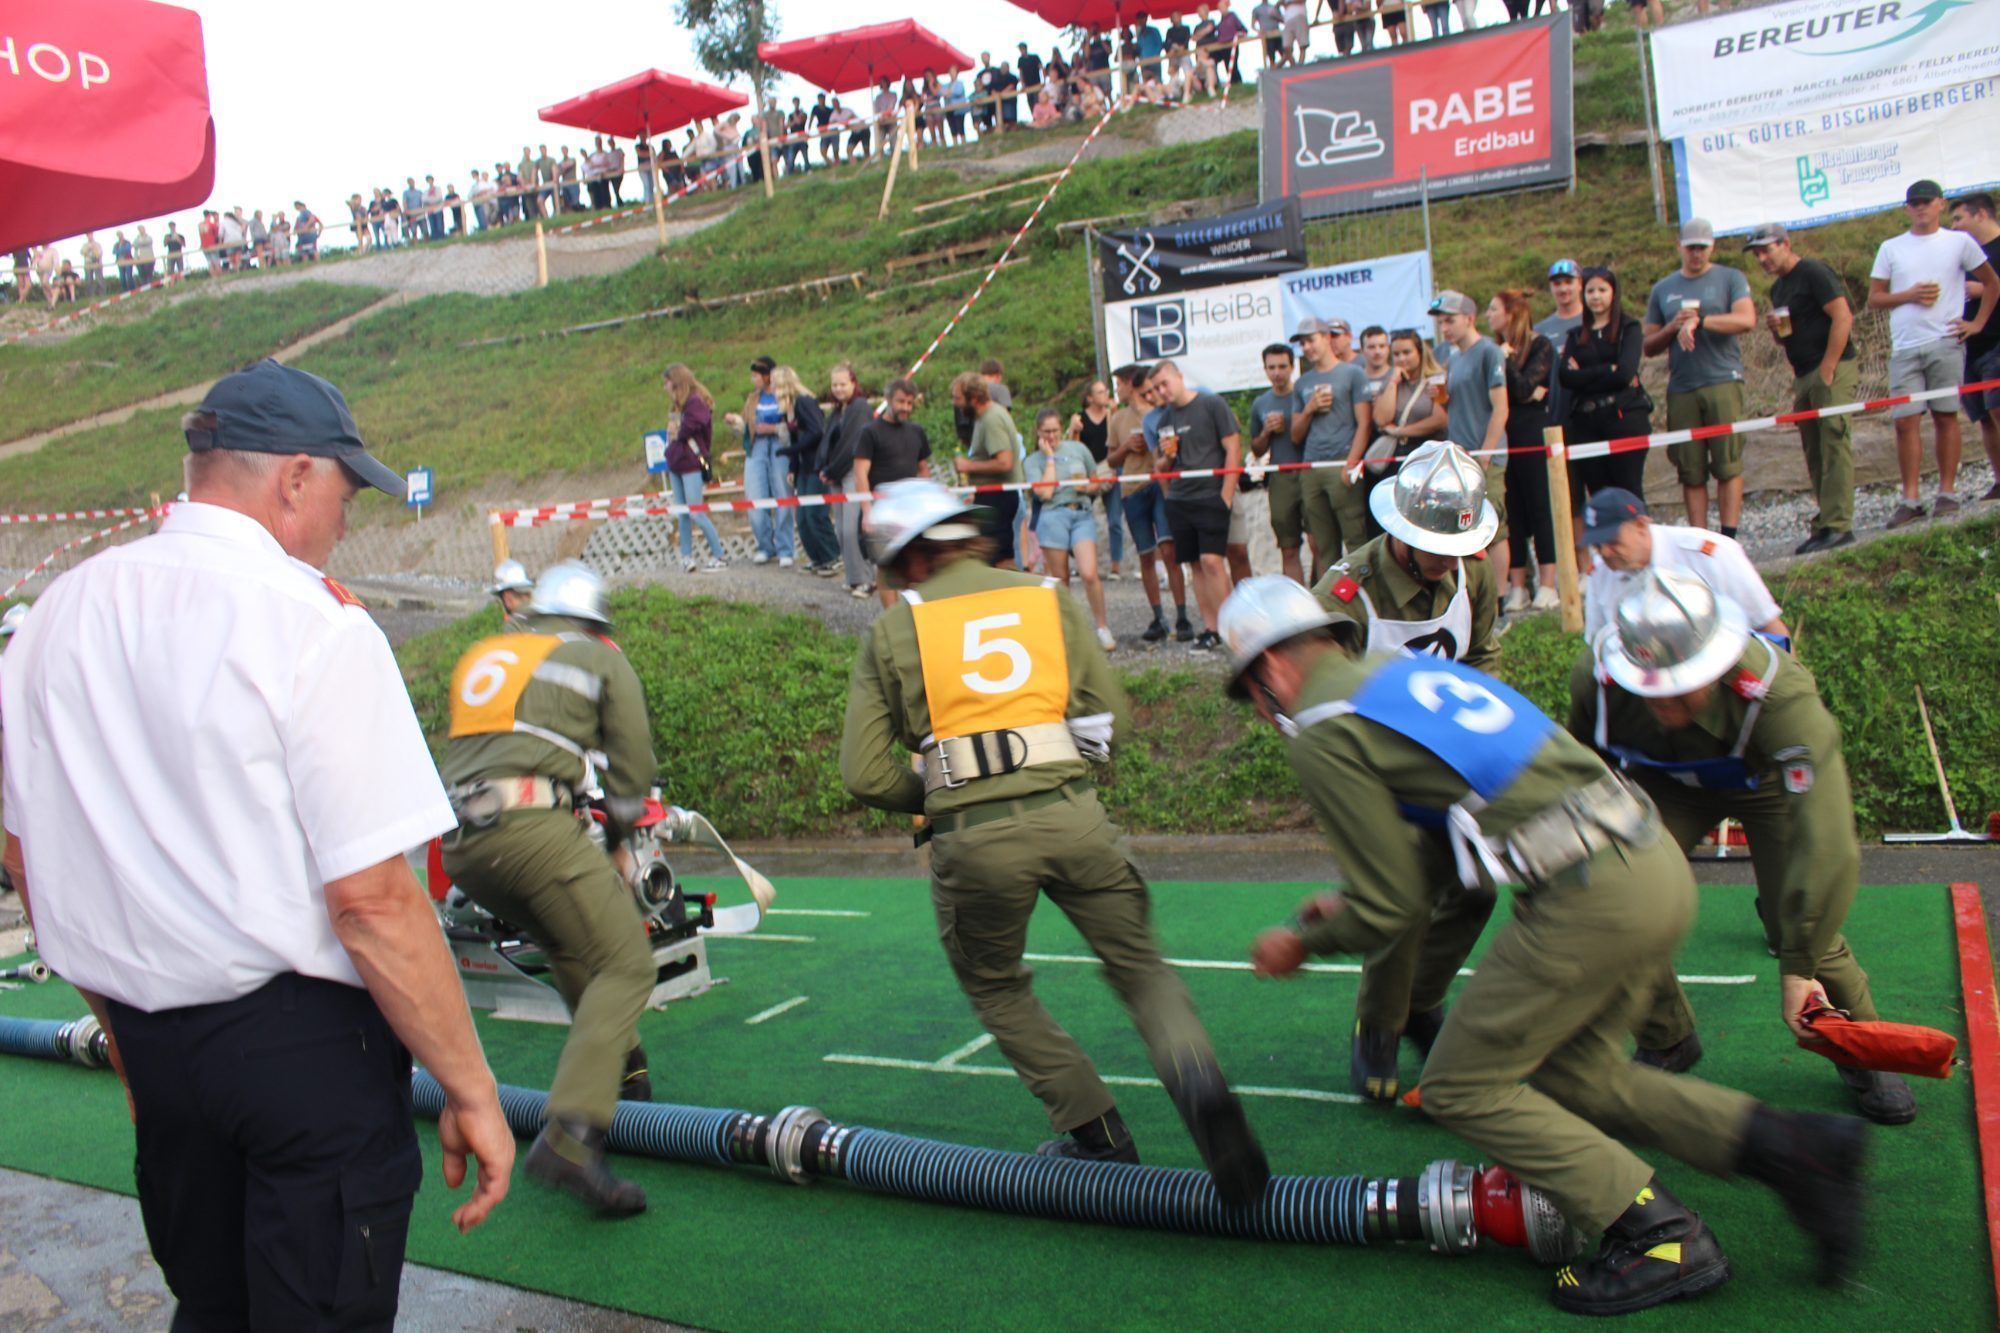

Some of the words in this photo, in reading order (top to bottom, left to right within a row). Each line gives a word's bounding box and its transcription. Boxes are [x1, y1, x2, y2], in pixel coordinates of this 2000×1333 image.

[1713, 1, 1902, 58] BEREUTER
[1410, 78, 1534, 135] RABE
[1673, 100, 1723, 117] NORBERT
[1727, 88, 1784, 107] BEREUTER
[1793, 78, 1838, 94] MARCEL
[1842, 64, 1908, 84] MALDONER
[1919, 55, 1954, 69] FELIX
[1455, 129, 1534, 157] Erdbau
[1703, 133, 1741, 153] GUT.
[1749, 119, 1814, 145] GÜTER.
[1822, 79, 1994, 131] BISCHOFBERGER!
[1175, 213, 1285, 248] DELLENTECHNIK
[1210, 238, 1251, 257] WINDER
[1287, 268, 1373, 294] THURNER
[1190, 292, 1272, 328] HeiBa
[462, 649, 520, 707] 6
[961, 612, 1032, 694] 5
[1407, 670, 1516, 735] 3
